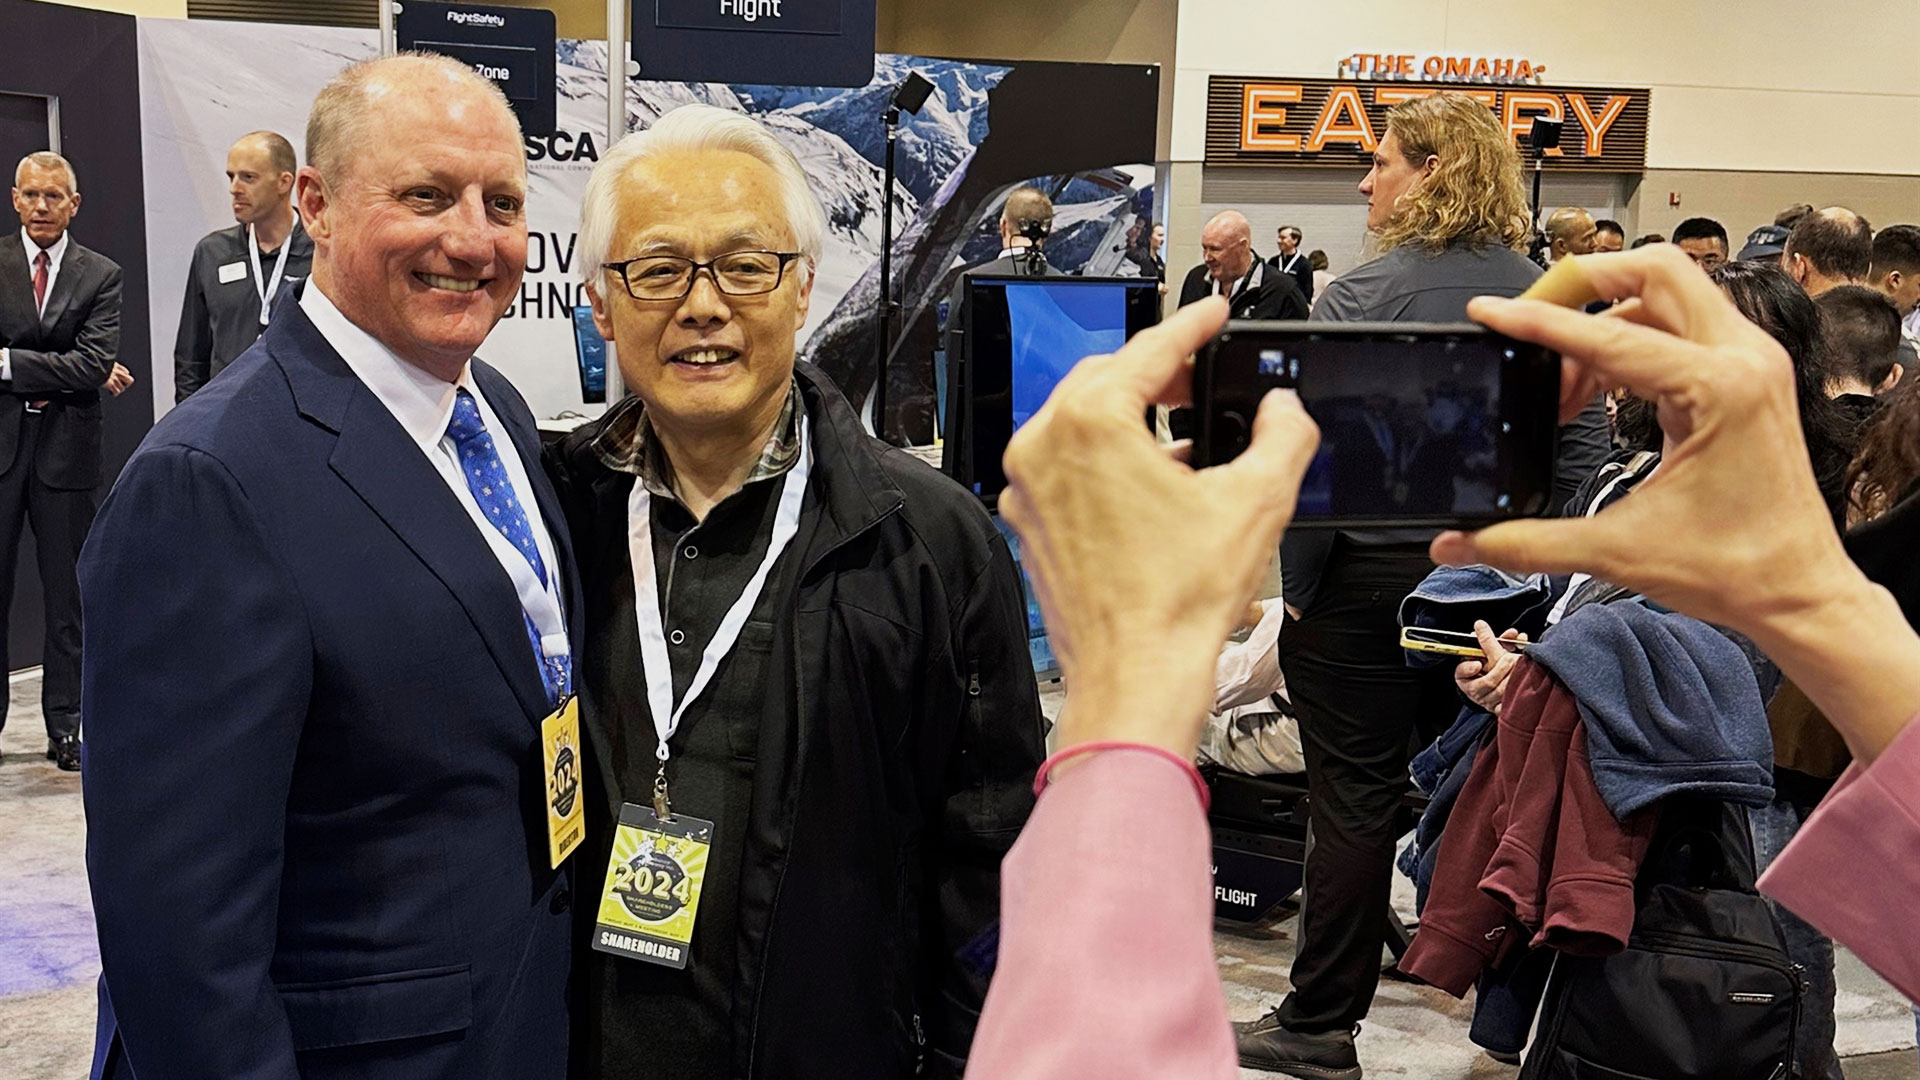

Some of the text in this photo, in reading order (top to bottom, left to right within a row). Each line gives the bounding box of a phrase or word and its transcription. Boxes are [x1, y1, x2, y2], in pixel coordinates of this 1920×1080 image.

[446, 11, 504, 27] FlightSafety
[1353, 53, 1534, 79] THE OMAHA
[1240, 83, 1632, 158] EARY
[613, 861, 692, 906] 2024
[1215, 886, 1258, 907] FLIGHT
[600, 931, 681, 961] SHAREHOLDER
